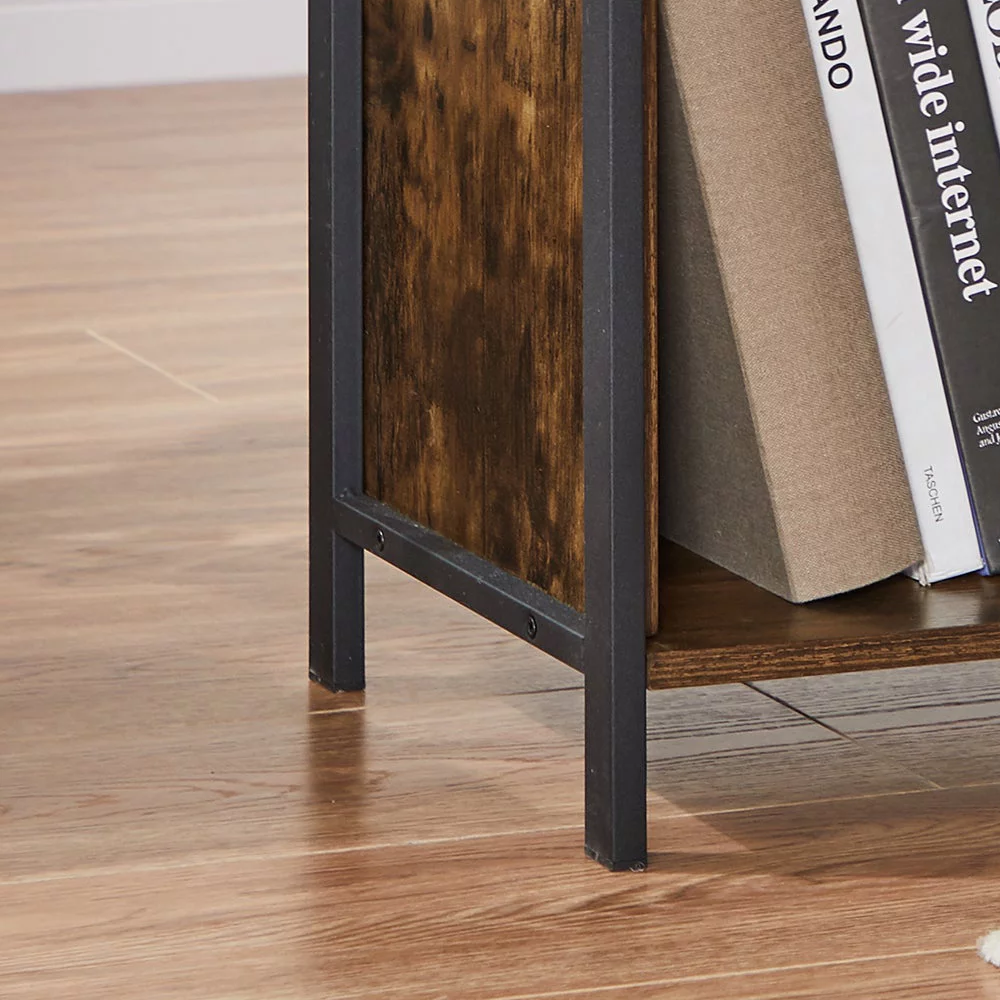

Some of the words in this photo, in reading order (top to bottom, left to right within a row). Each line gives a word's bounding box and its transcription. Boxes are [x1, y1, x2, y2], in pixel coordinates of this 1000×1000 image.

[902, 9, 954, 117] wide
[925, 120, 998, 302] internet
[979, 433, 996, 448] and
[924, 465, 944, 522] TASCHEN
